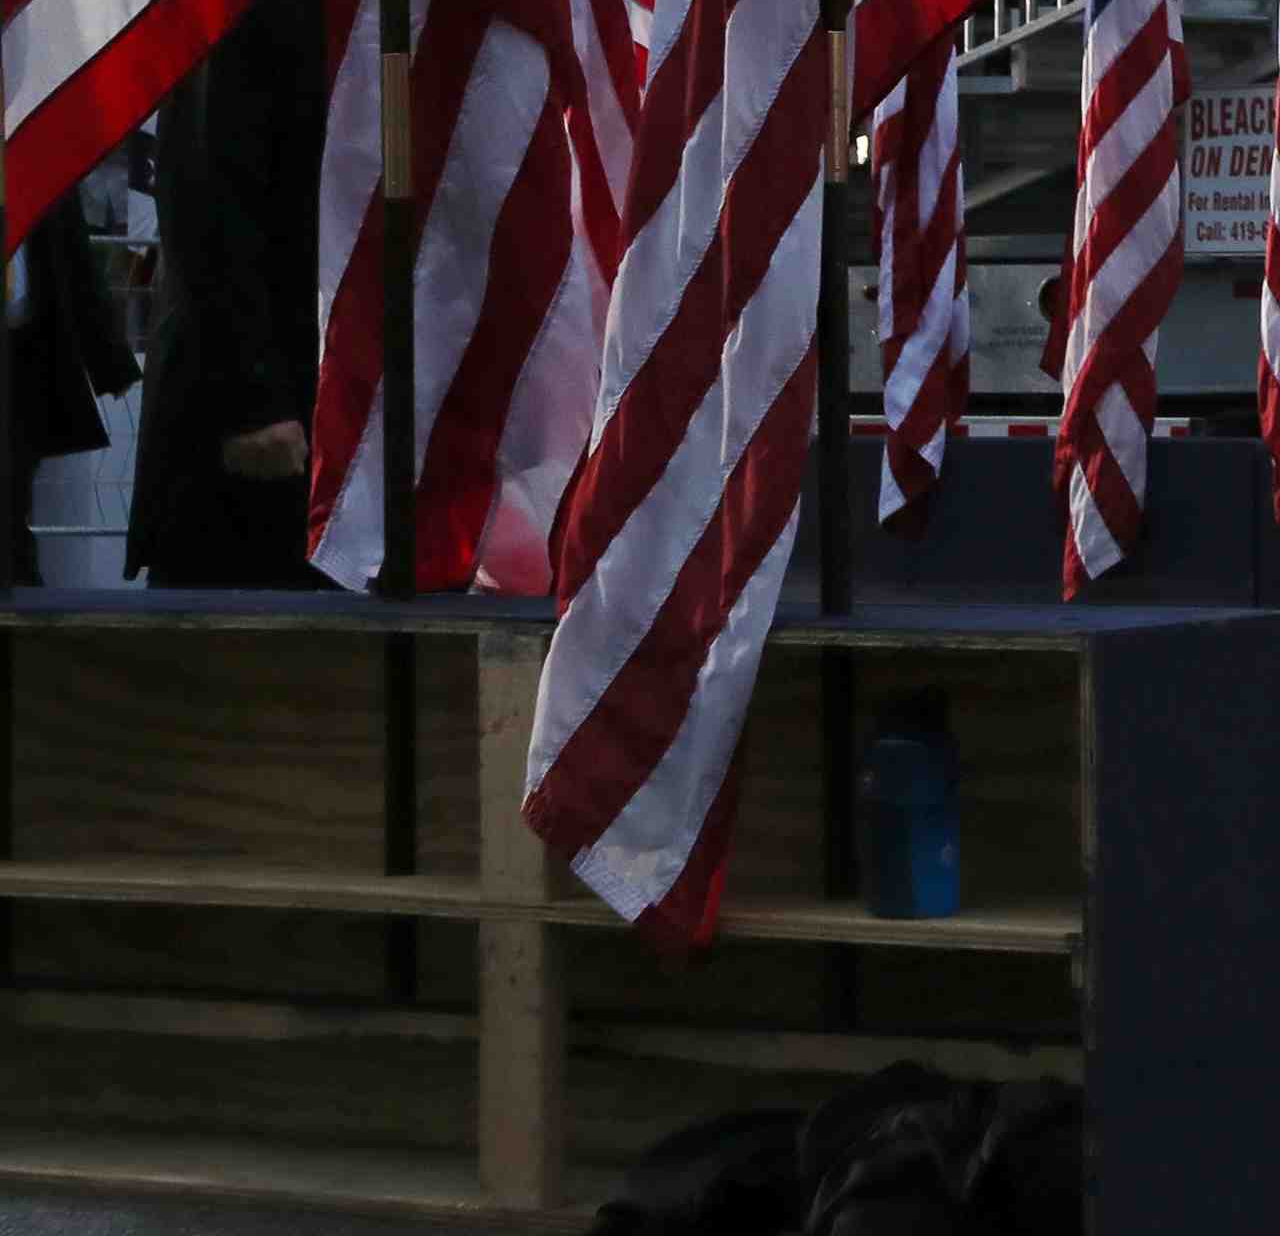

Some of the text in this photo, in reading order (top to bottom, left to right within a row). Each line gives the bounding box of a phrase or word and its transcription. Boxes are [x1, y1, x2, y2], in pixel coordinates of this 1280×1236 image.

[1191, 145, 1223, 178] ON
[1188, 191, 1208, 212] For
[1213, 191, 1256, 212] Rental
[1196, 221, 1227, 241] Call:
